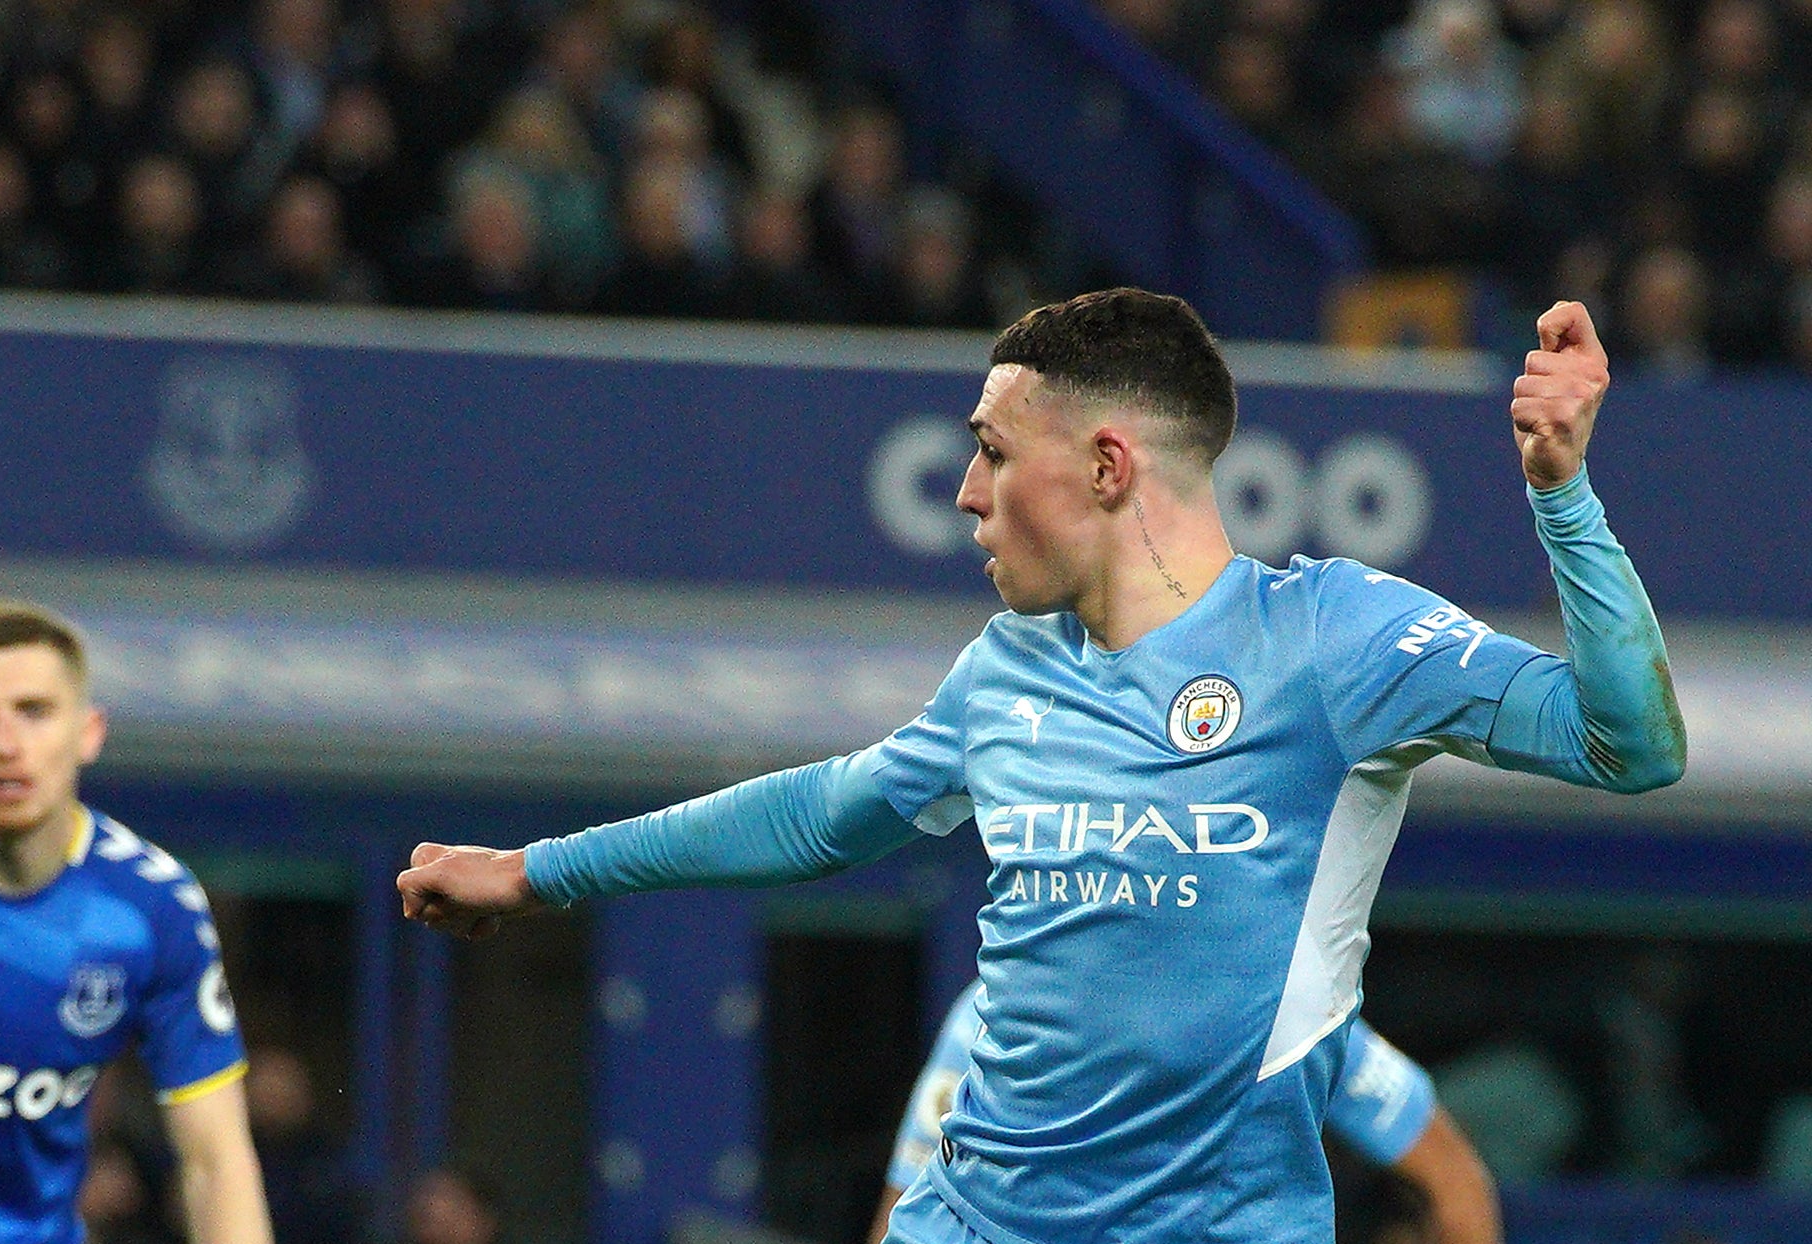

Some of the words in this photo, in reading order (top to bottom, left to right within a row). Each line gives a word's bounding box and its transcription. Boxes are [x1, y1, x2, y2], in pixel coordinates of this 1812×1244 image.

[1177, 681, 1237, 711] MANCHESTER
[1189, 741, 1213, 751] CITY
[988, 802, 1269, 854] ETIHAD
[1009, 869, 1198, 908] AIRWAYS
